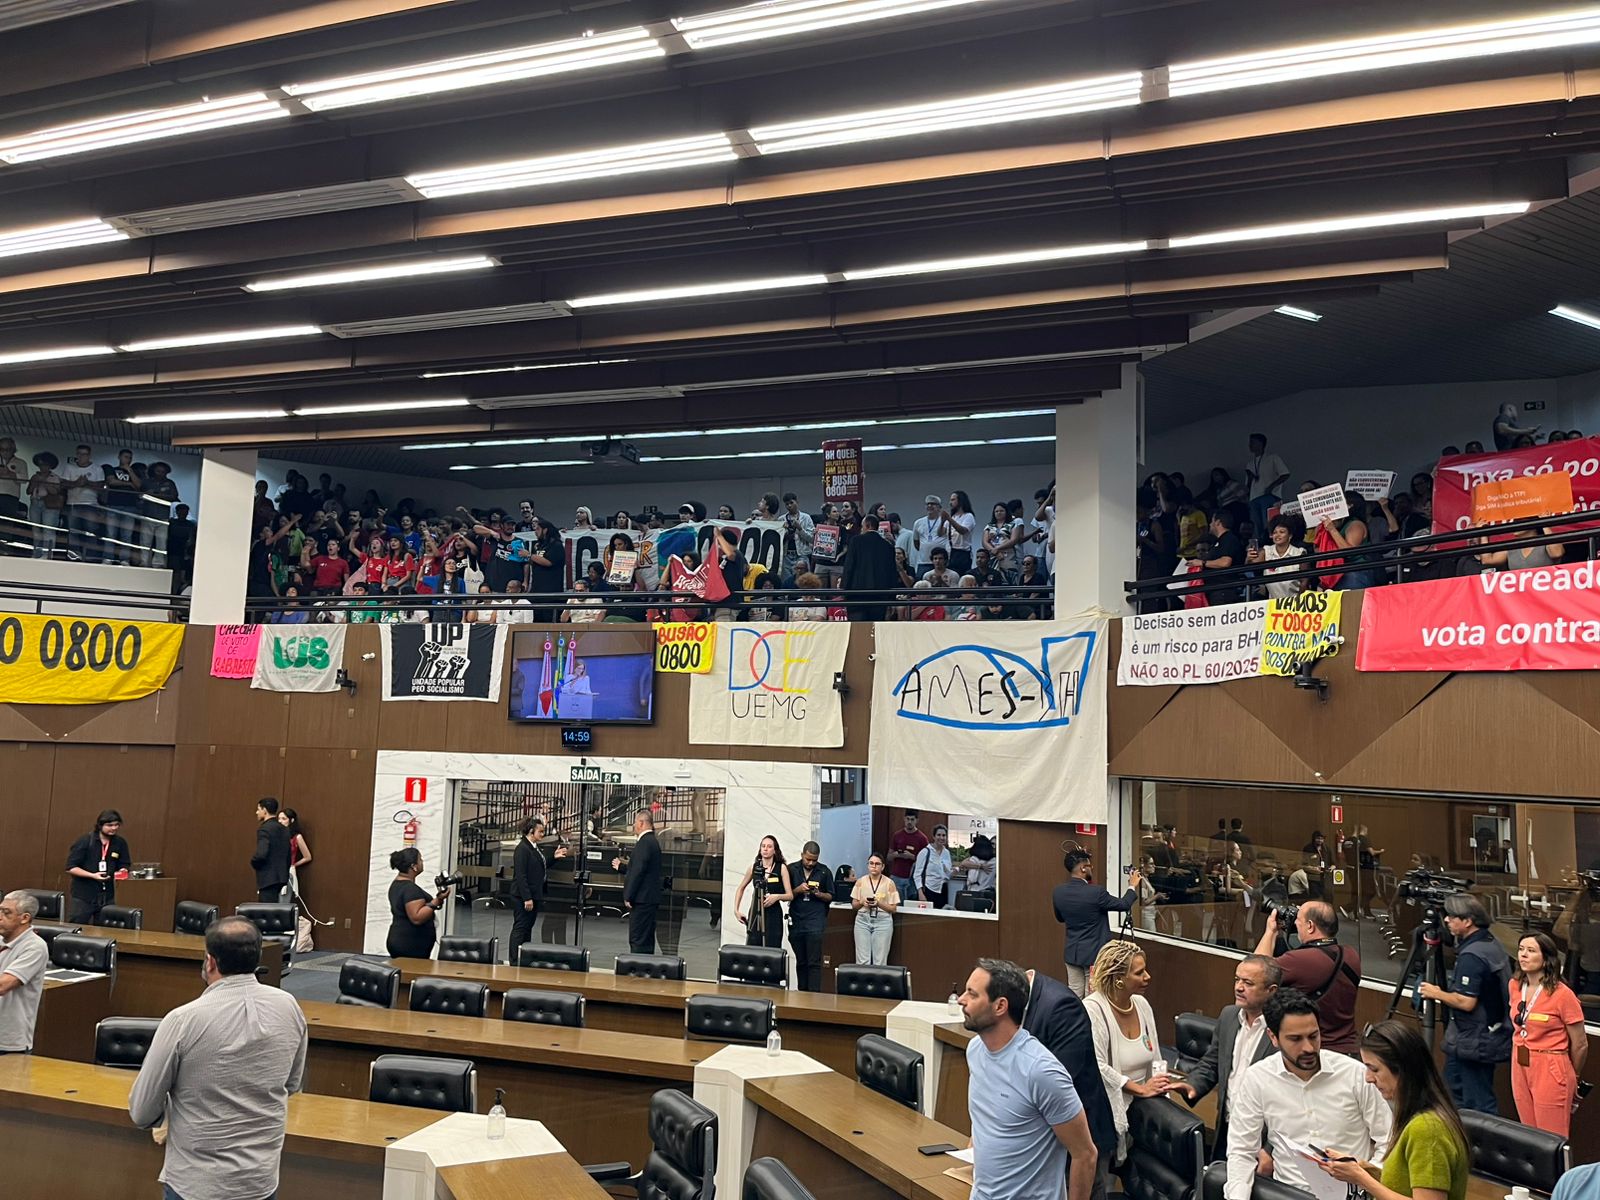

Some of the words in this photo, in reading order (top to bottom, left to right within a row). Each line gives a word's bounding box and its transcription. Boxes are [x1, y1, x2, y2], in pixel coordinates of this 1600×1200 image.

[825, 450, 835, 460] BH
[836, 448, 858, 460] QUER:
[832, 473, 857, 486] BUSÃO
[825, 486, 846, 497] 0800
[1275, 593, 1328, 613] VAMOS
[1134, 614, 1184, 631] Decisão
[1187, 615, 1216, 628] sem
[1221, 606, 1265, 625] dados
[1271, 613, 1322, 633] TODOS
[431, 623, 464, 646] UP
[657, 623, 708, 646] BUSÃO
[1265, 632, 1306, 650] CONTRA
[1421, 621, 1486, 647] vota
[1495, 617, 1600, 645] contra
[39, 619, 142, 672] 0800
[1131, 640, 1139, 655] é
[1143, 642, 1160, 654] um
[1164, 639, 1198, 653] risco
[1201, 639, 1233, 656] para
[1237, 630, 1263, 650] BH!
[660, 642, 701, 670] 0800
[728, 628, 816, 693] DCE
[1130, 661, 1159, 678] NÃO
[1162, 666, 1179, 678] ao
[1182, 663, 1201, 679] PL
[1204, 657, 1259, 678] 60/2025
[426, 686, 465, 694] SOCIALISMO
[437, 678, 465, 686] POPULAR
[732, 692, 807, 720] UEMG
[563, 731, 590, 742] 14:59
[571, 766, 600, 781] SAÍDA
